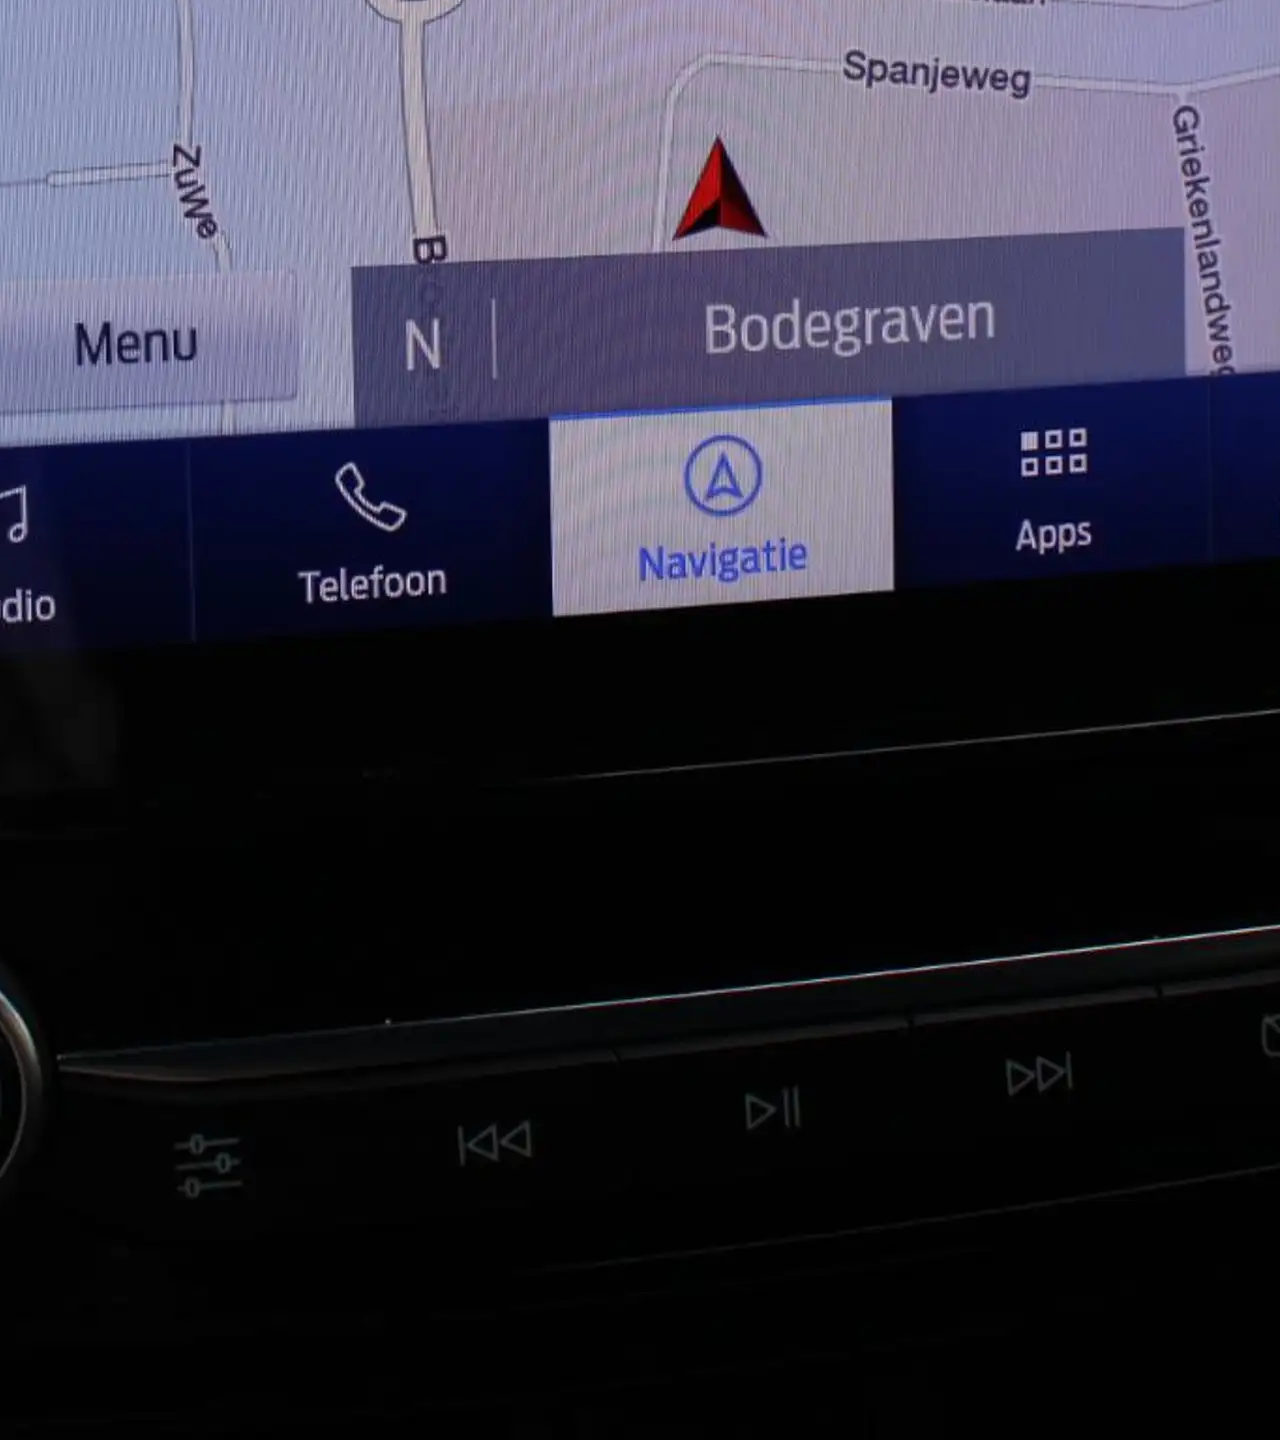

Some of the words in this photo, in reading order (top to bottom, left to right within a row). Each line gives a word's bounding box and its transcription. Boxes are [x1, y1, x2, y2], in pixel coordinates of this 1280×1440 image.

[844, 50, 1030, 99] Spanjeweg
[76, 322, 197, 365] Menu
[406, 319, 439, 370] N
[706, 299, 994, 357] Bodegraven
[640, 537, 807, 582] Navigatie
[1016, 520, 1091, 554] Apps
[299, 565, 446, 602] Telefoon
